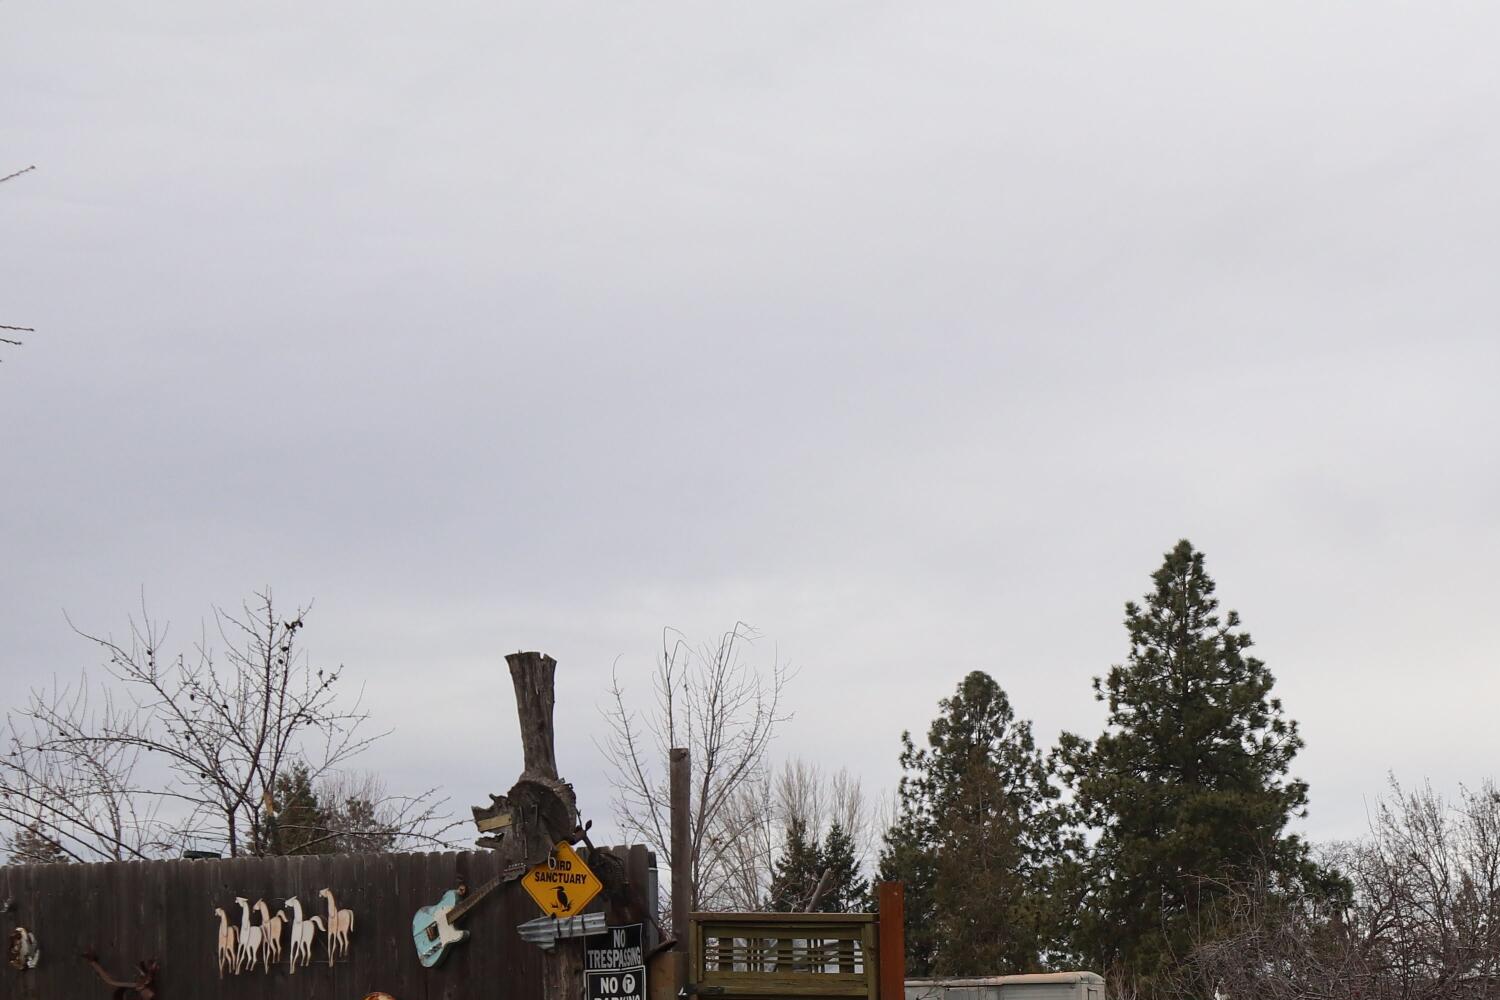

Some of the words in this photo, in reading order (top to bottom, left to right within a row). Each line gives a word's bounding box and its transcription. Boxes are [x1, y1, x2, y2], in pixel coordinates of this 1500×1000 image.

[535, 872, 587, 884] SANCTUARY
[613, 929, 626, 948] NO
[587, 946, 641, 969] TRESPASSING
[600, 976, 618, 994] NO
